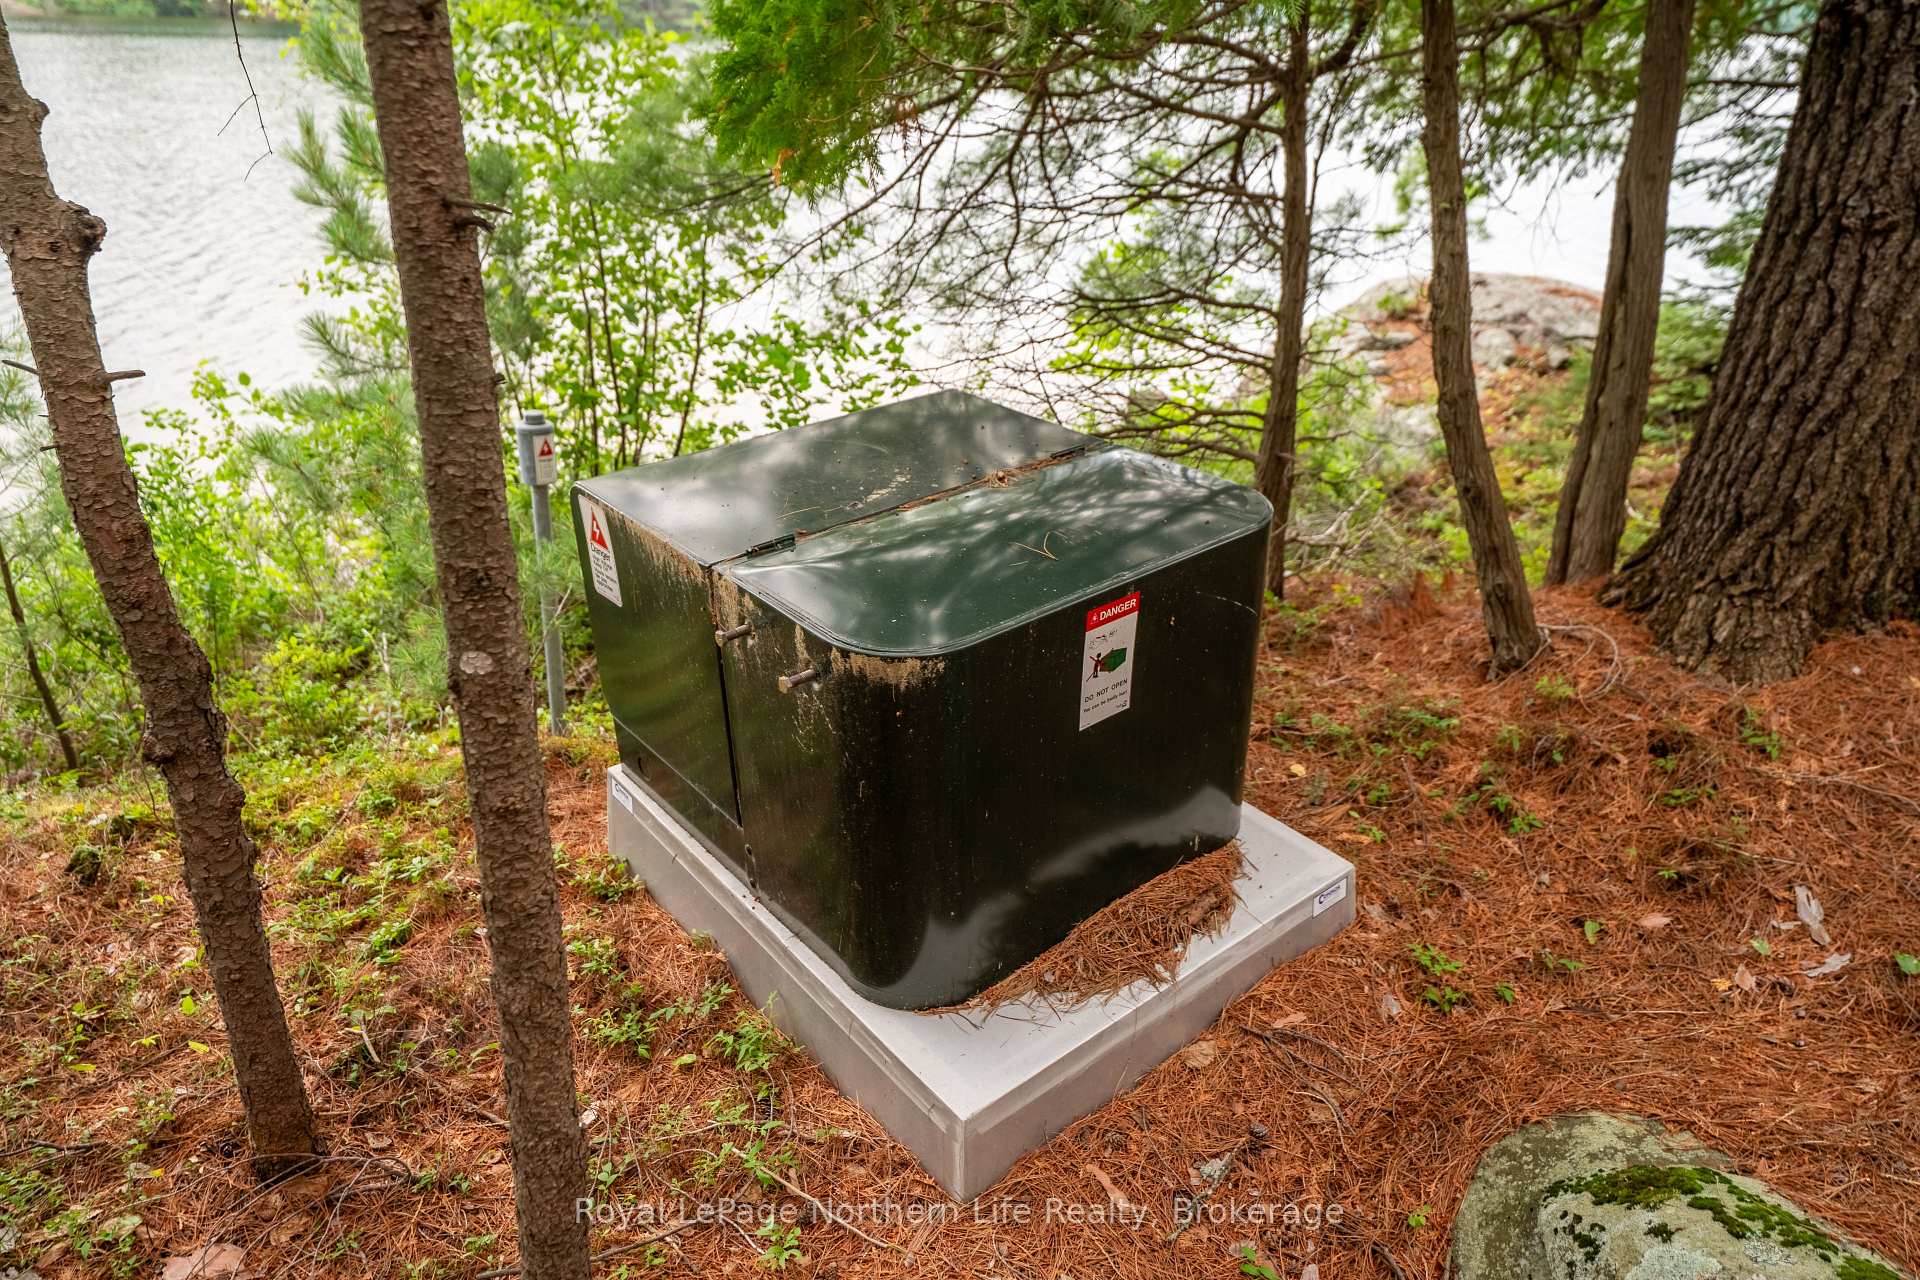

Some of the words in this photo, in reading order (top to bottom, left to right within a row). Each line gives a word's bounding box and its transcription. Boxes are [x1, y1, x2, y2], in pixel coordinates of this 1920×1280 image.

[1100, 599, 1137, 621] DANGER
[1084, 694, 1094, 703] DO
[1096, 686, 1109, 697] NOT
[1111, 678, 1128, 690] OPEN
